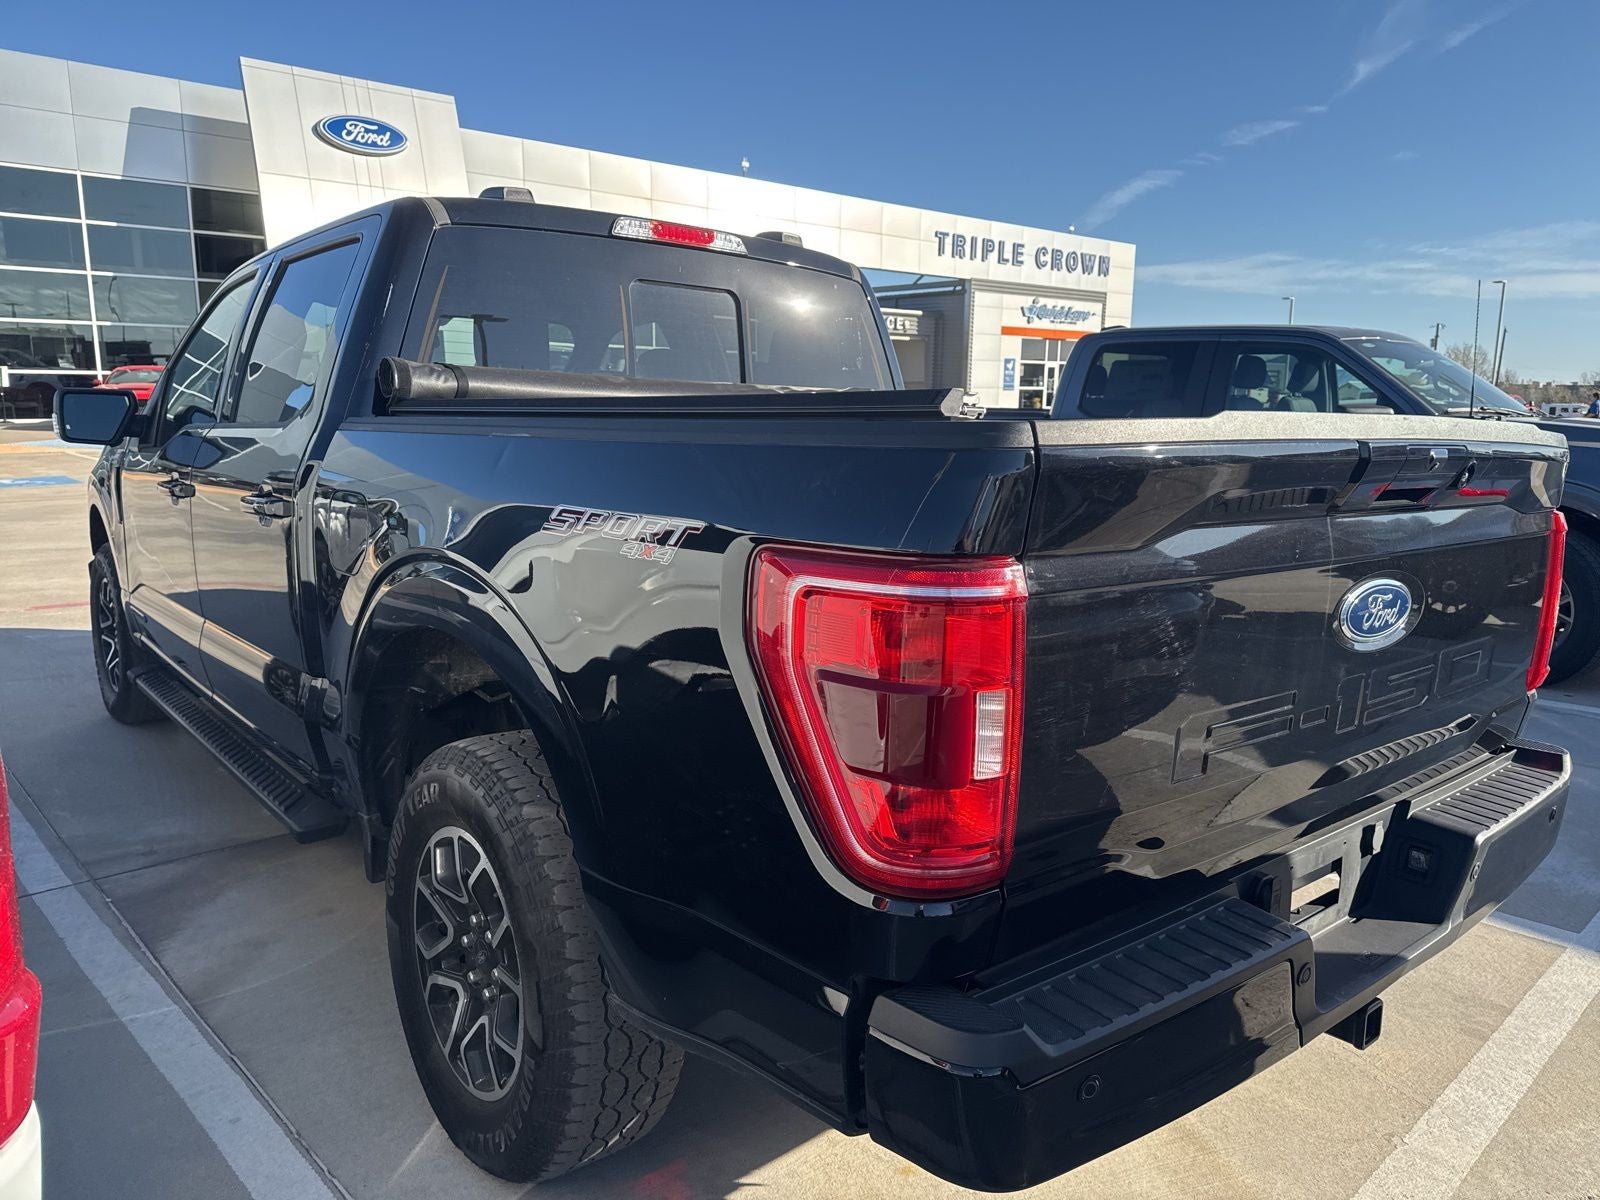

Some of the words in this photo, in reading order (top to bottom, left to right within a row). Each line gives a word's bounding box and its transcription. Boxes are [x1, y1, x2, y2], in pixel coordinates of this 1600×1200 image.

[341, 120, 391, 147] Ford
[935, 230, 1025, 267] TRIPLE
[1035, 246, 1111, 277] CROWN
[540, 504, 706, 549] SPORT
[1362, 593, 1401, 631] Ford
[1171, 636, 1495, 784] F-150
